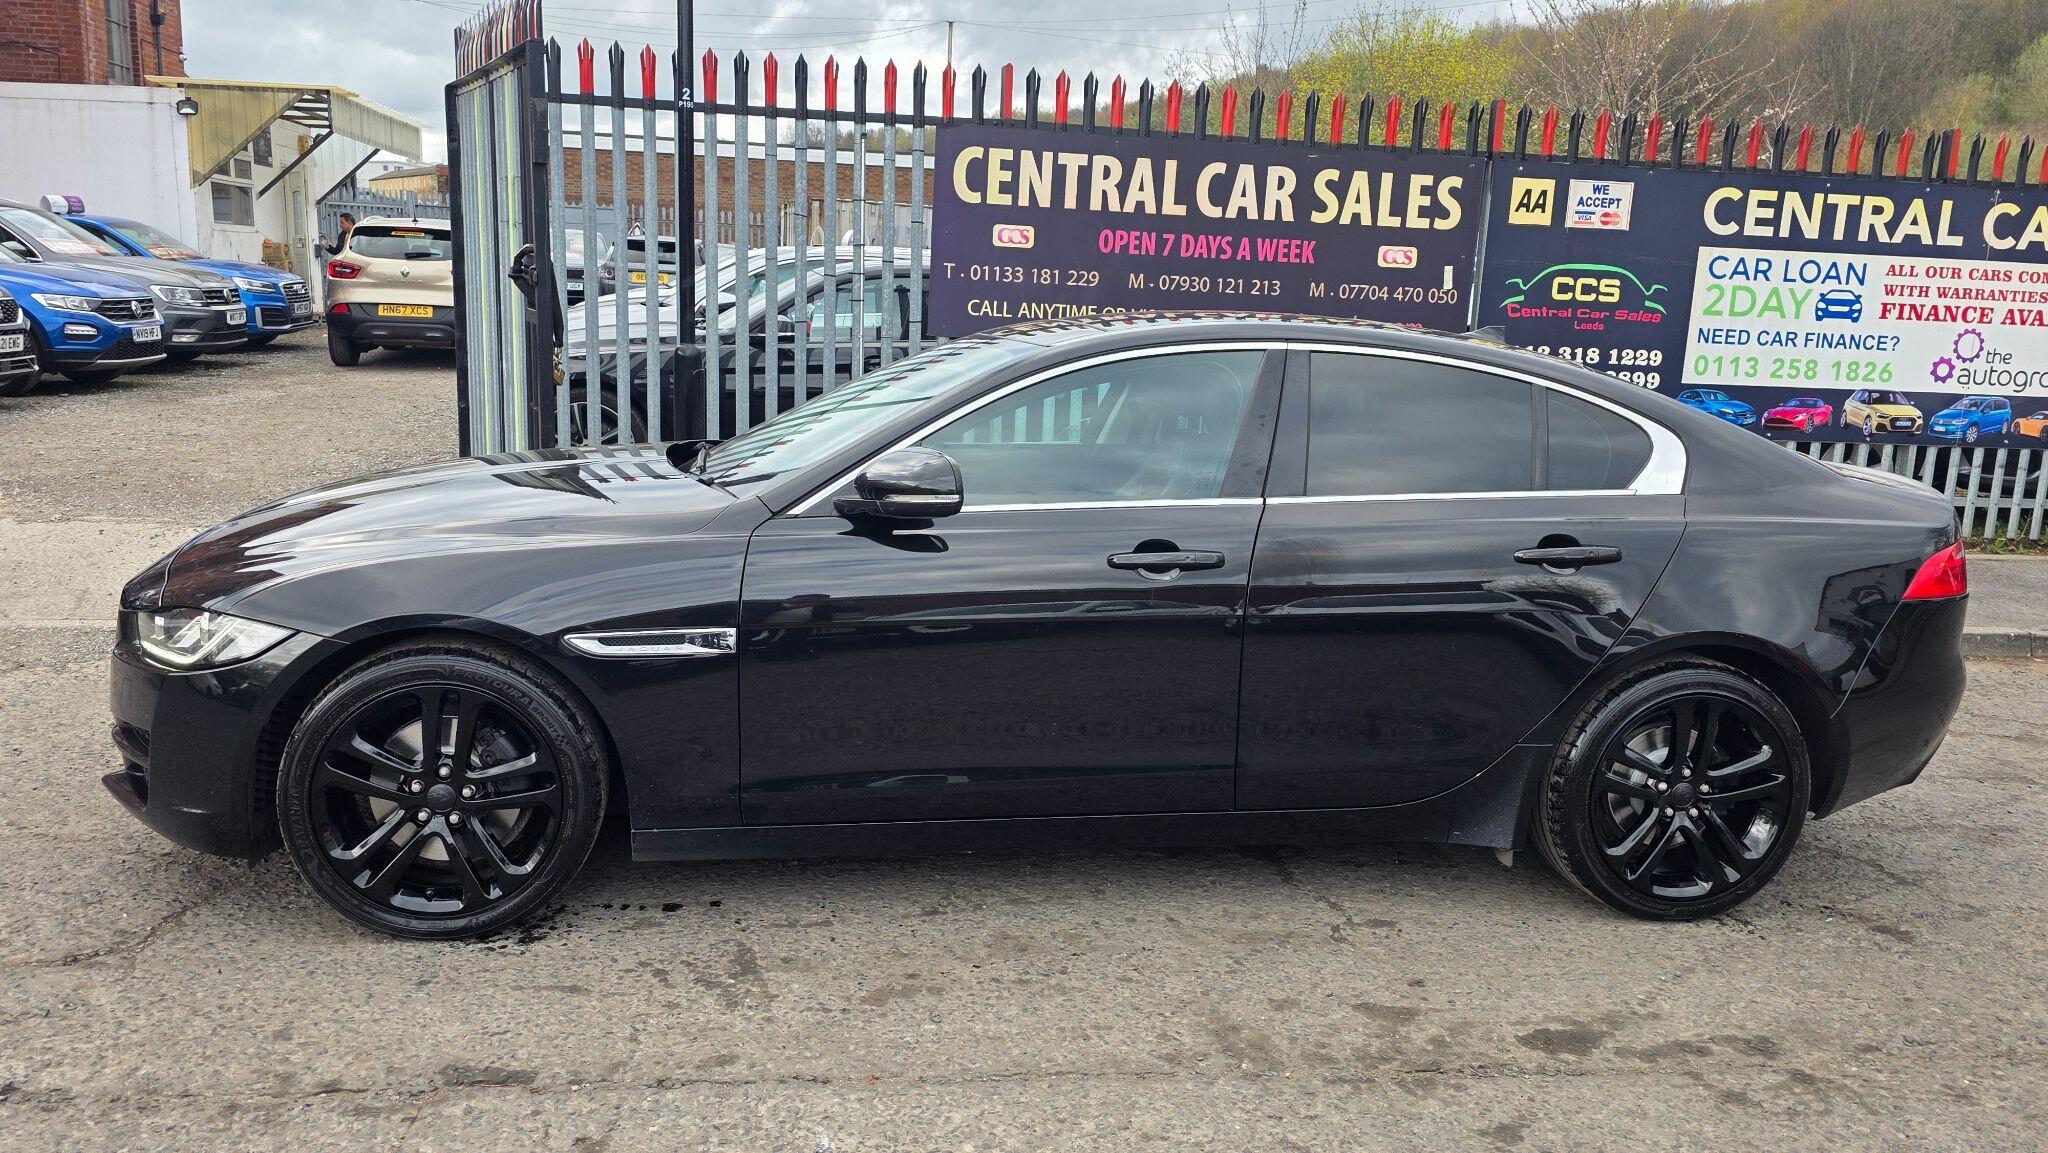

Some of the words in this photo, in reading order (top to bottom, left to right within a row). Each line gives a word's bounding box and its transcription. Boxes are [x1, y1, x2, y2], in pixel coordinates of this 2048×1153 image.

[682, 87, 690, 100] 2
[952, 145, 1187, 216] CENTRAL
[1196, 161, 1297, 222] CAR
[1310, 168, 1463, 230] SALES
[1592, 183, 1610, 195] WE
[1514, 188, 1548, 214] AA
[1576, 196, 1622, 209] ACCEPT
[1703, 186, 1964, 247] CENTRAL
[1982, 202, 2048, 252] CA
[997, 227, 1030, 245] CCS
[1099, 229, 1156, 255] OPEN
[1162, 233, 1175, 257] 7
[1181, 234, 1232, 260] DAYS
[1237, 237, 1250, 261] A
[1257, 238, 1316, 264] WEEK
[1382, 248, 1413, 266] CCS
[970, 264, 1024, 283] 01133
[1031, 268, 1059, 285] 181
[1065, 270, 1100, 287] 229
[1708, 255, 1773, 282] CAR
[1783, 259, 1867, 286] LOAN
[1885, 264, 1919, 278] ALL
[1925, 266, 1962, 279] OUR
[1968, 268, 2013, 282] CARS
[1158, 274, 1210, 293] 07930
[1217, 277, 1244, 294] 121
[1251, 279, 1281, 296] 213
[1339, 284, 1388, 300] 07704
[1393, 286, 1423, 302] 470
[1428, 288, 1458, 304] 050
[1552, 276, 1621, 303] CCS
[1883, 284, 1930, 298] WITH
[1936, 287, 2048, 304] WARRANTIES
[382, 305, 409, 314] HN67
[410, 306, 428, 315] XCS
[967, 299, 1012, 318] CALL
[1017, 302, 1097, 320] ANYTIME
[1702, 283, 1814, 320] 2DAY
[1506, 303, 1572, 318] Central
[1577, 308, 1609, 319] Car
[1614, 309, 1662, 323] Sales
[1879, 302, 1994, 325] FINANCE
[1574, 321, 1604, 330] Leeds
[1697, 327, 1751, 346] NEED
[1756, 330, 1798, 348] CAR
[1804, 332, 1901, 351] FINANCE?
[1558, 346, 1600, 365] 318
[1608, 349, 1663, 367] 1229
[1985, 348, 2013, 365] the
[1694, 354, 1759, 378] 0113
[1769, 357, 1819, 381] 258
[1831, 360, 1893, 383] 1826
[453, 668, 531, 707] PROTOURA
[529, 705, 561, 741] SPORT
